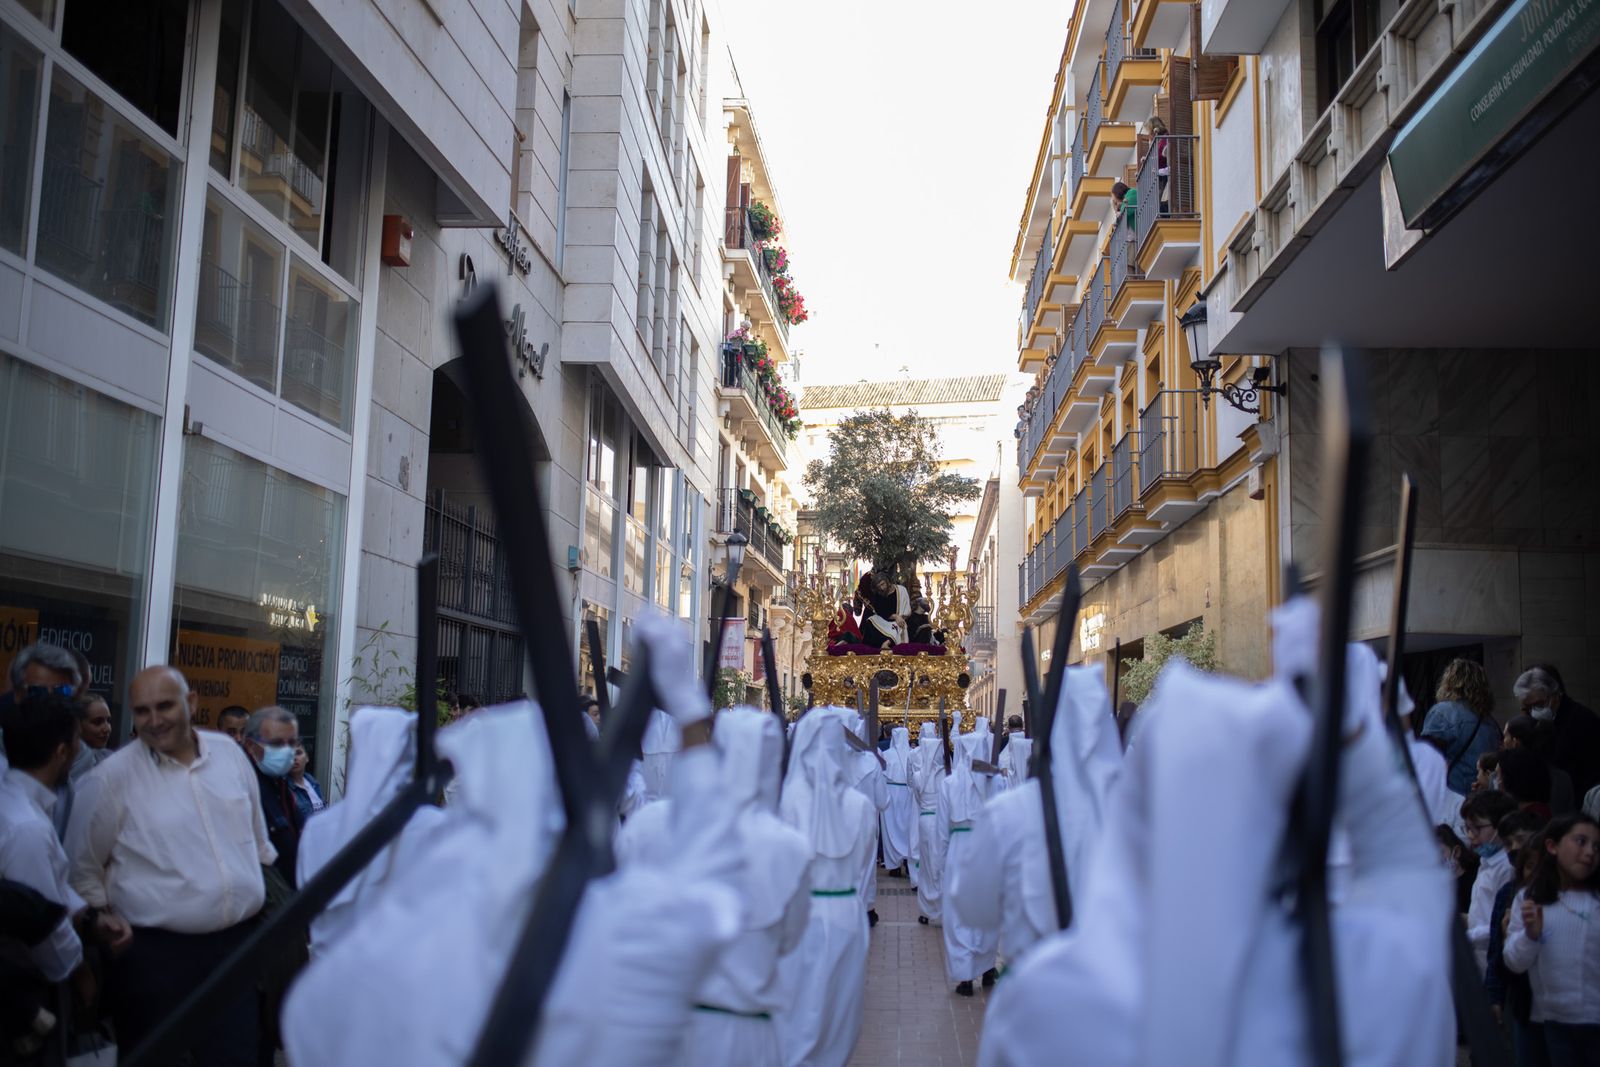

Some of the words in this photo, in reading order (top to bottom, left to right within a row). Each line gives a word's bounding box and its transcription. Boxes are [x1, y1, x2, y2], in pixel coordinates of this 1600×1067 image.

[1470, 79, 1504, 121] CONSEJERÍA
[178, 643, 214, 667] NUEVA
[217, 648, 276, 673] PROMOCIÓN
[280, 655, 309, 672] EDIFICIO
[279, 680, 294, 694] DON
[296, 681, 319, 697] MIGUEL
